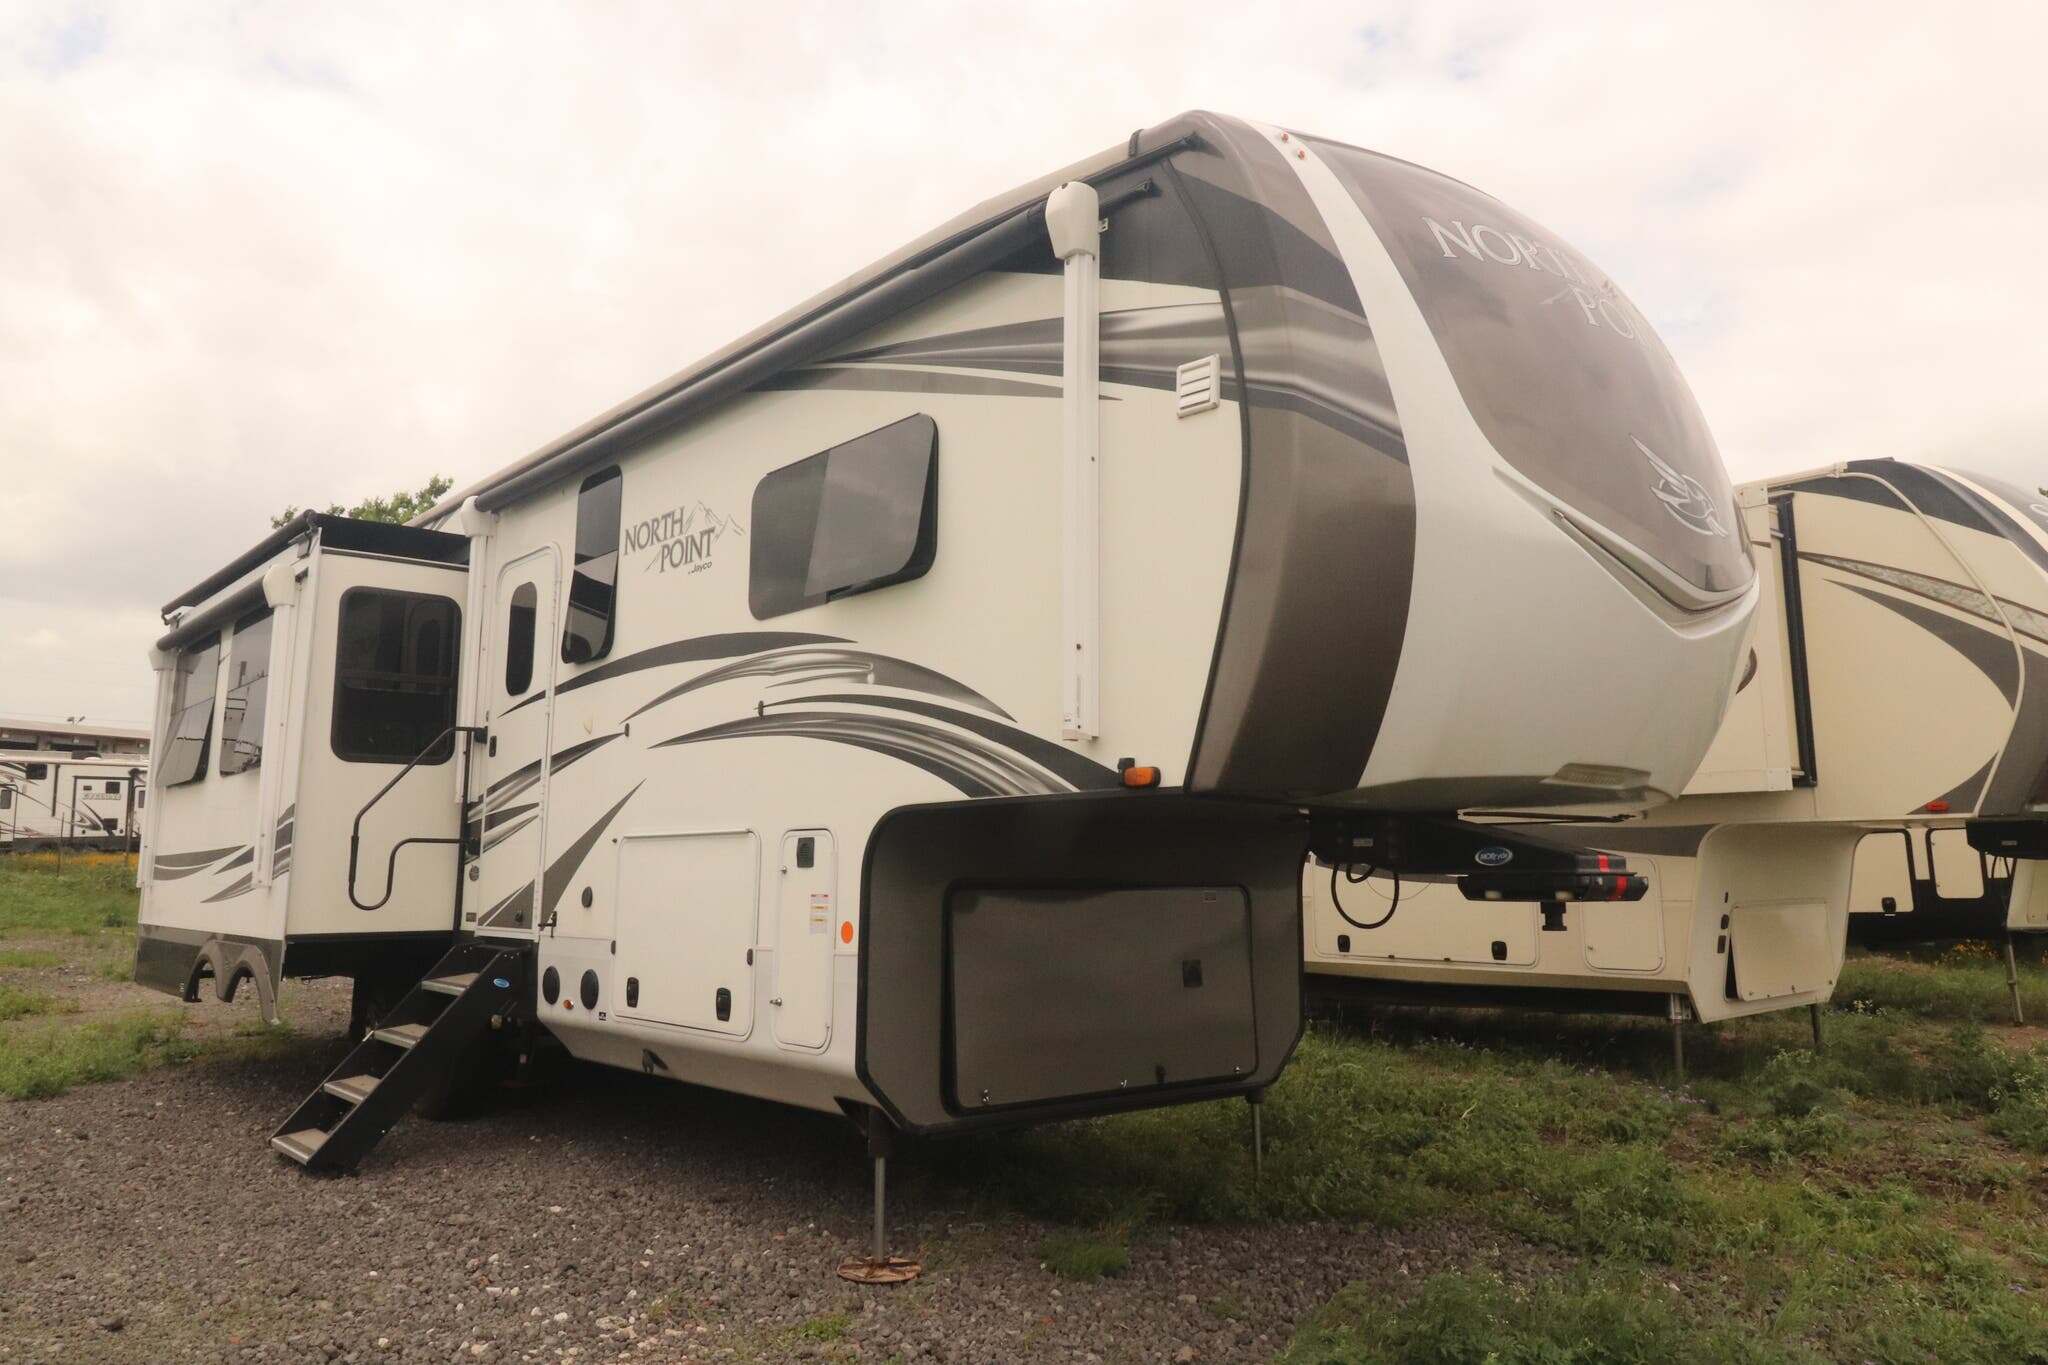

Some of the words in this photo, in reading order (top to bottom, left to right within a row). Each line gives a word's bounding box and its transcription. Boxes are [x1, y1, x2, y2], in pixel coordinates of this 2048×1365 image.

[623, 506, 685, 556] NORTH
[659, 526, 716, 574] POINT
[690, 560, 713, 574] Jayco
